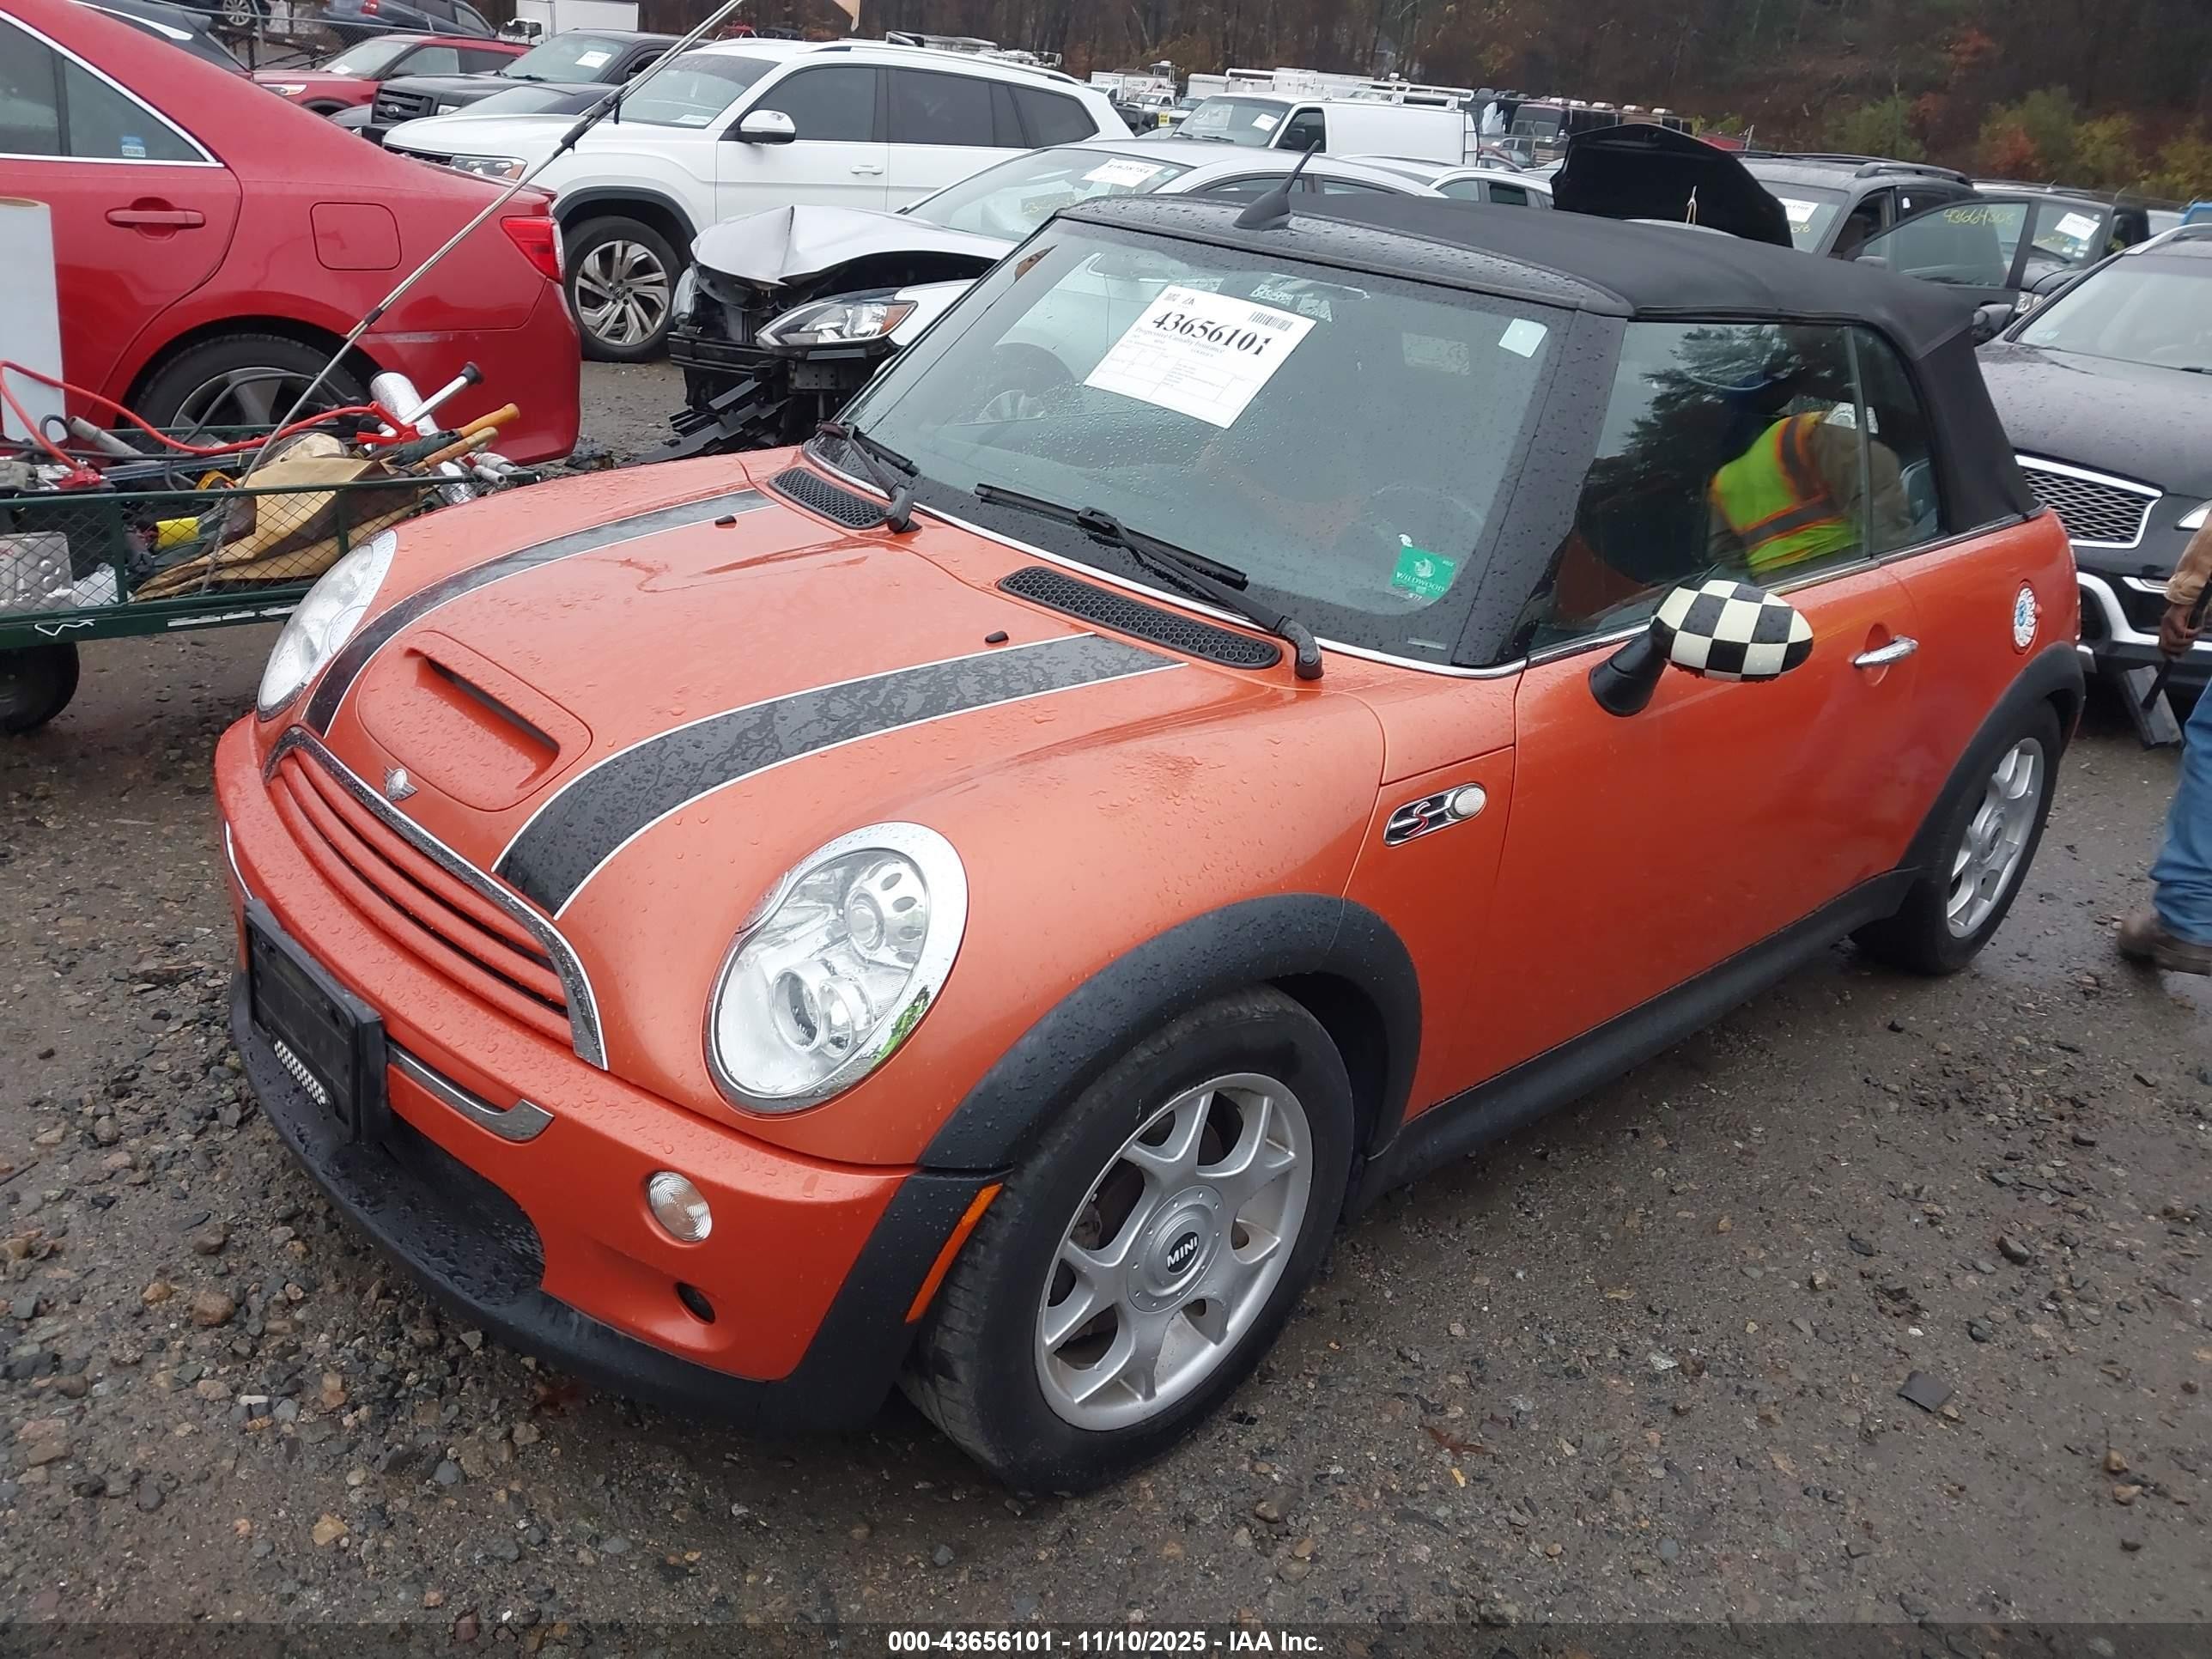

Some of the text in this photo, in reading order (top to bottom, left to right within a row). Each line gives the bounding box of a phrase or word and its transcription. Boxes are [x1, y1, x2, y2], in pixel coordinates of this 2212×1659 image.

[1152, 311, 1273, 356] 43656101
[1396, 571, 1444, 592] WILDWOOD
[1404, 801, 1431, 836] S
[1167, 1237, 1197, 1267] MINI
